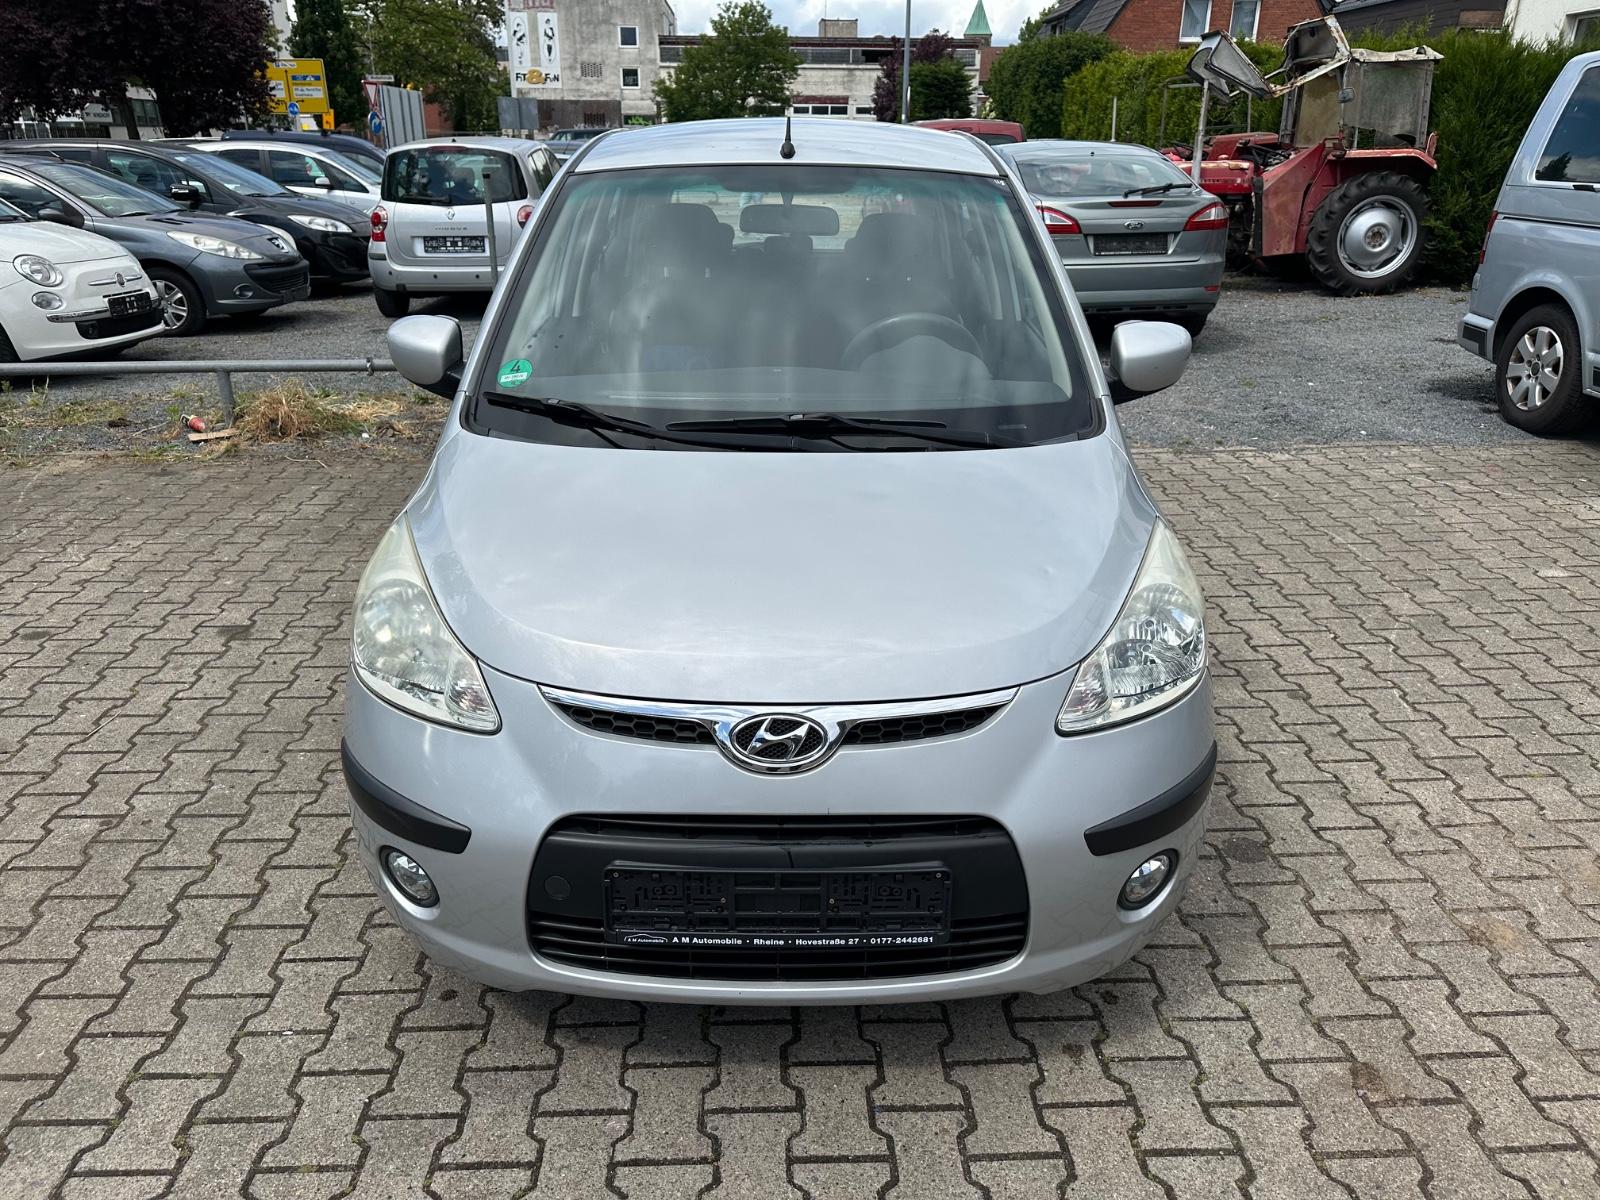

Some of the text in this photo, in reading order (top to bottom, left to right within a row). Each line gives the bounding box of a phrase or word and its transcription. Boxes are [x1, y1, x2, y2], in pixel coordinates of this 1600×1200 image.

[510, 360, 521, 373] 4
[681, 936, 690, 944] M
[692, 937, 743, 945] Automobile
[753, 938, 785, 946] Rheine
[795, 938, 846, 946] Hovestraße
[870, 936, 934, 945] 0177-2442681
